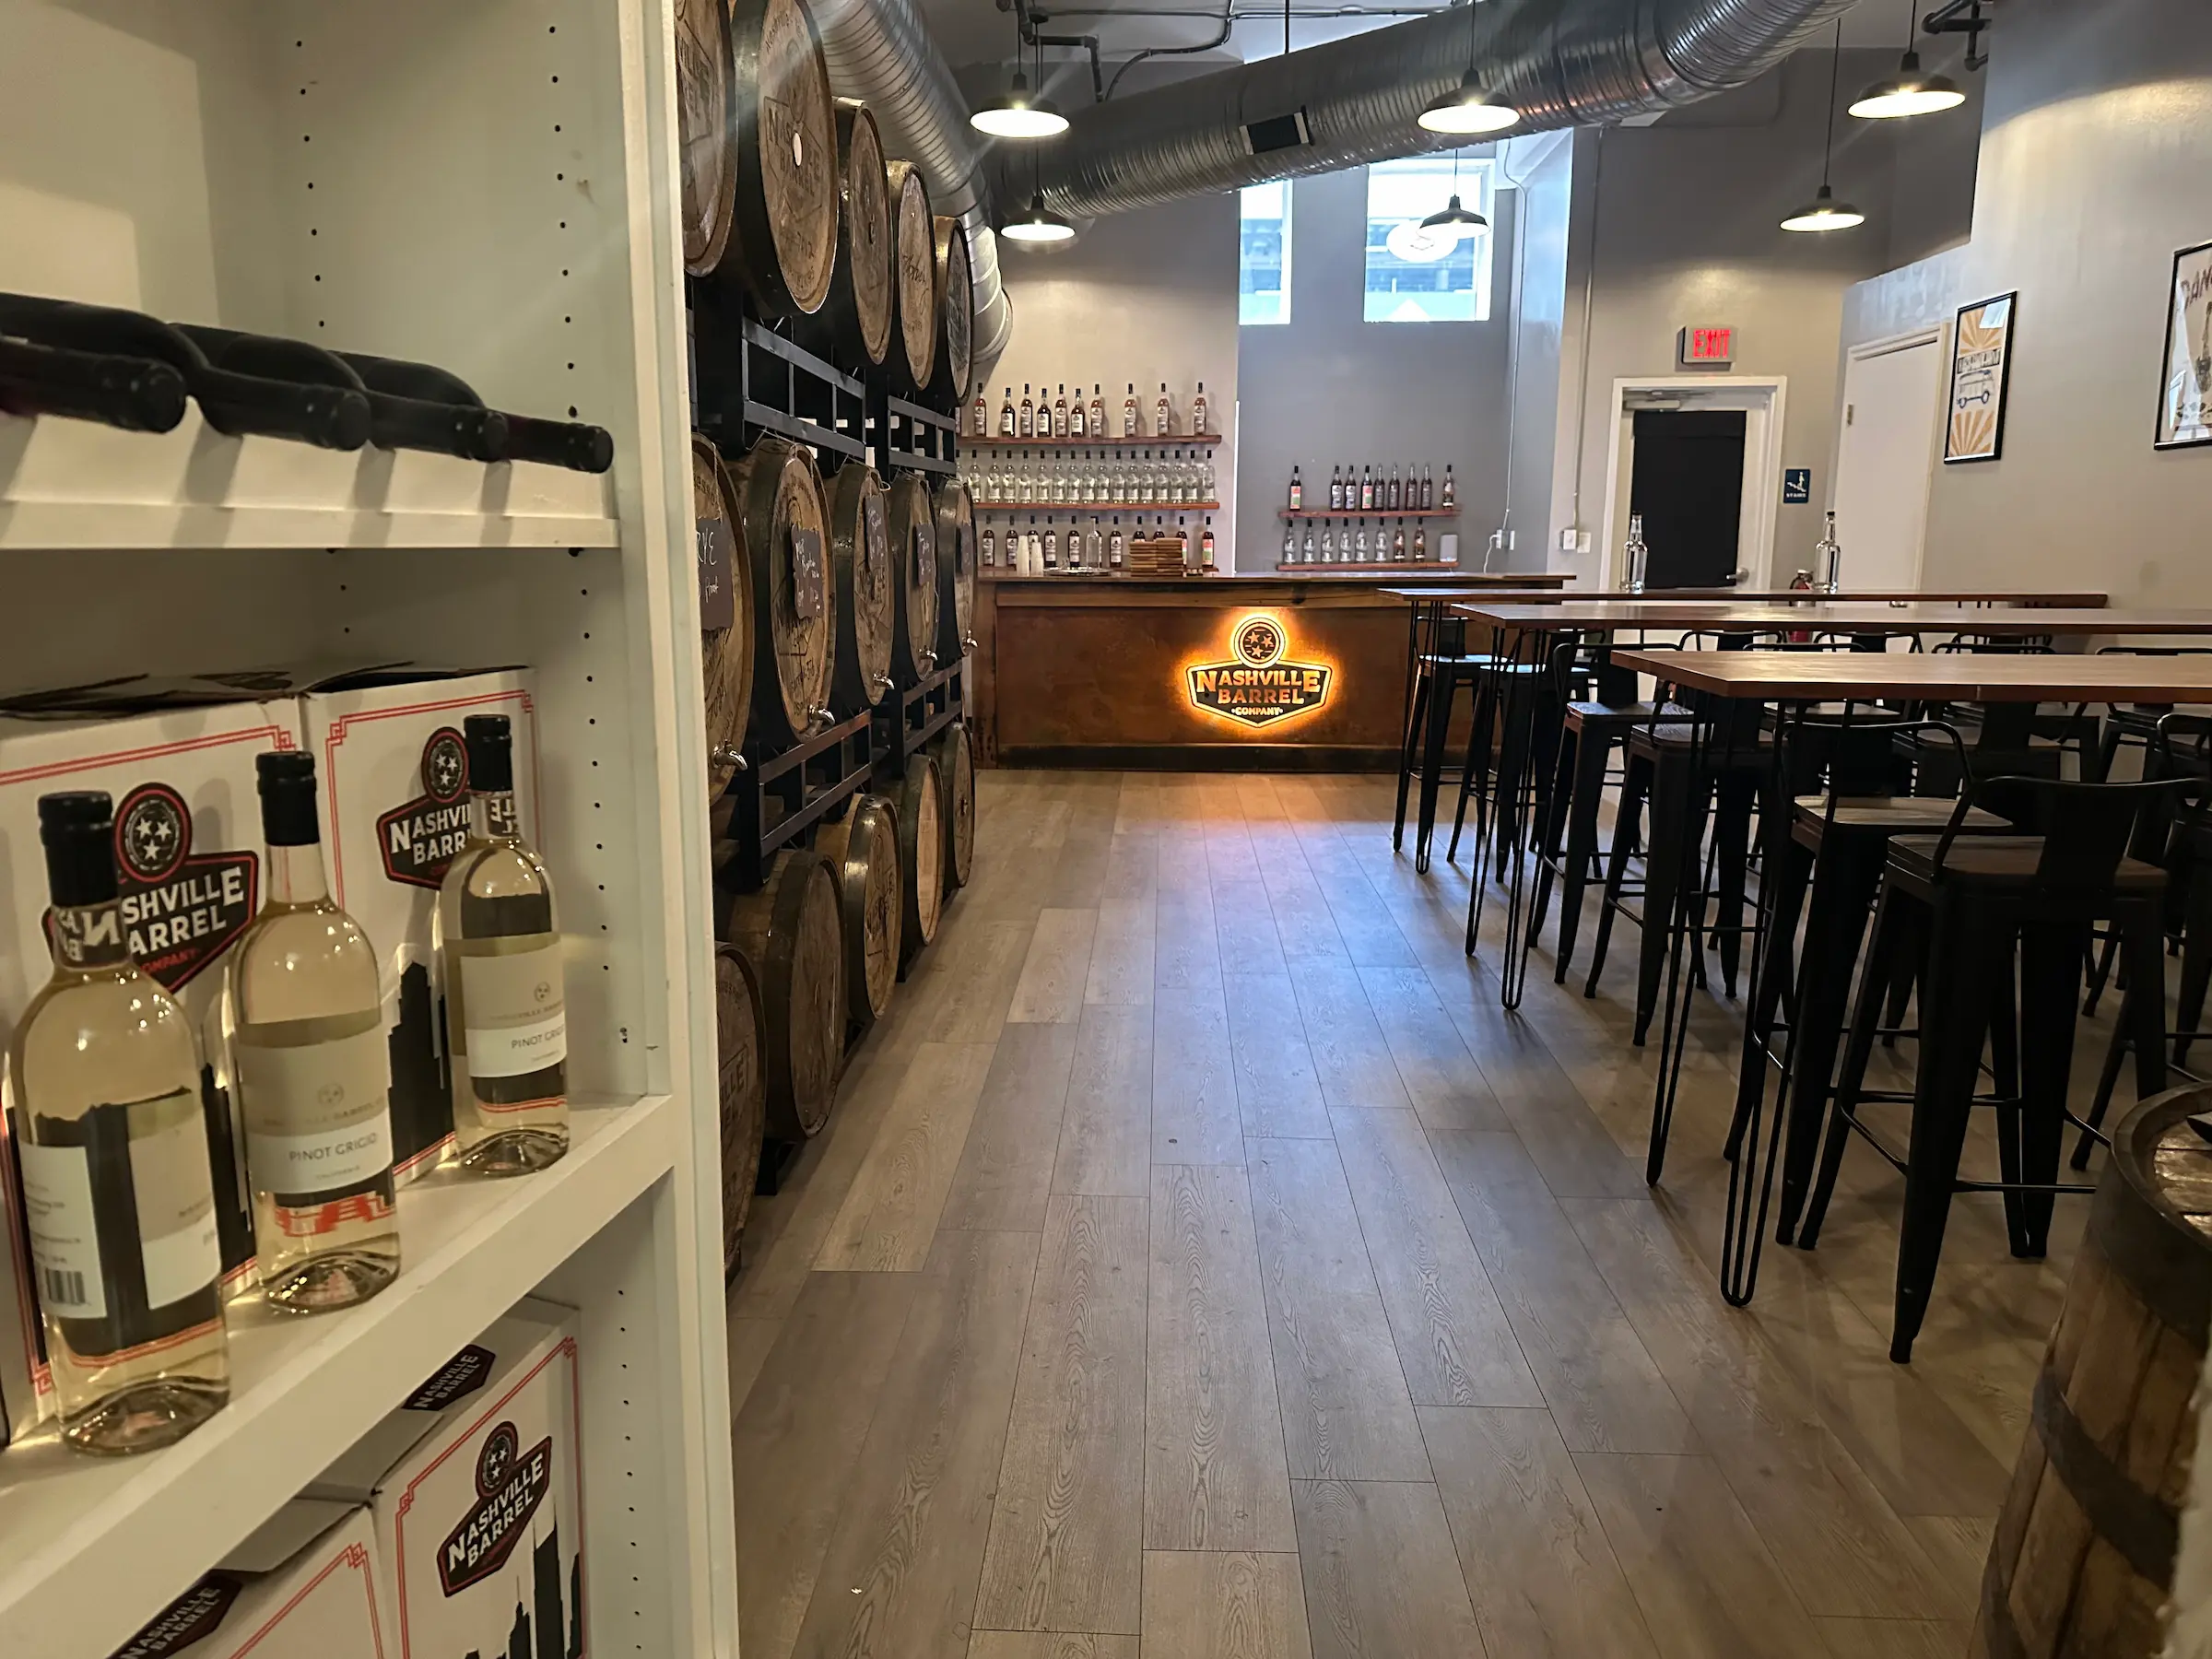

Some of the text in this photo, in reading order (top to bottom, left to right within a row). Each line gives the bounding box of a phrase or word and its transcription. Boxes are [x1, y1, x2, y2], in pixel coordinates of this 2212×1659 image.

[1692, 329, 1732, 359] EXIT
[1196, 670, 1322, 693] NASHVILLE
[1217, 688, 1305, 704] BARREL
[1234, 706, 1281, 716] COMPANY
[389, 803, 472, 854] NASHVI
[413, 829, 472, 865] BARR
[121, 865, 245, 925] SHVILLE
[128, 904, 228, 956] ARREL
[511, 1033, 543, 1049] PINOT
[288, 1133, 378, 1162] PINOT GRIGIO
[413, 1354, 479, 1408] NASHVILLE
[434, 1363, 481, 1398] BARREL
[448, 1453, 544, 1572] NASHVILLE
[466, 1488, 535, 1568] BARREL
[119, 1587, 221, 1659] NASHVILLE
